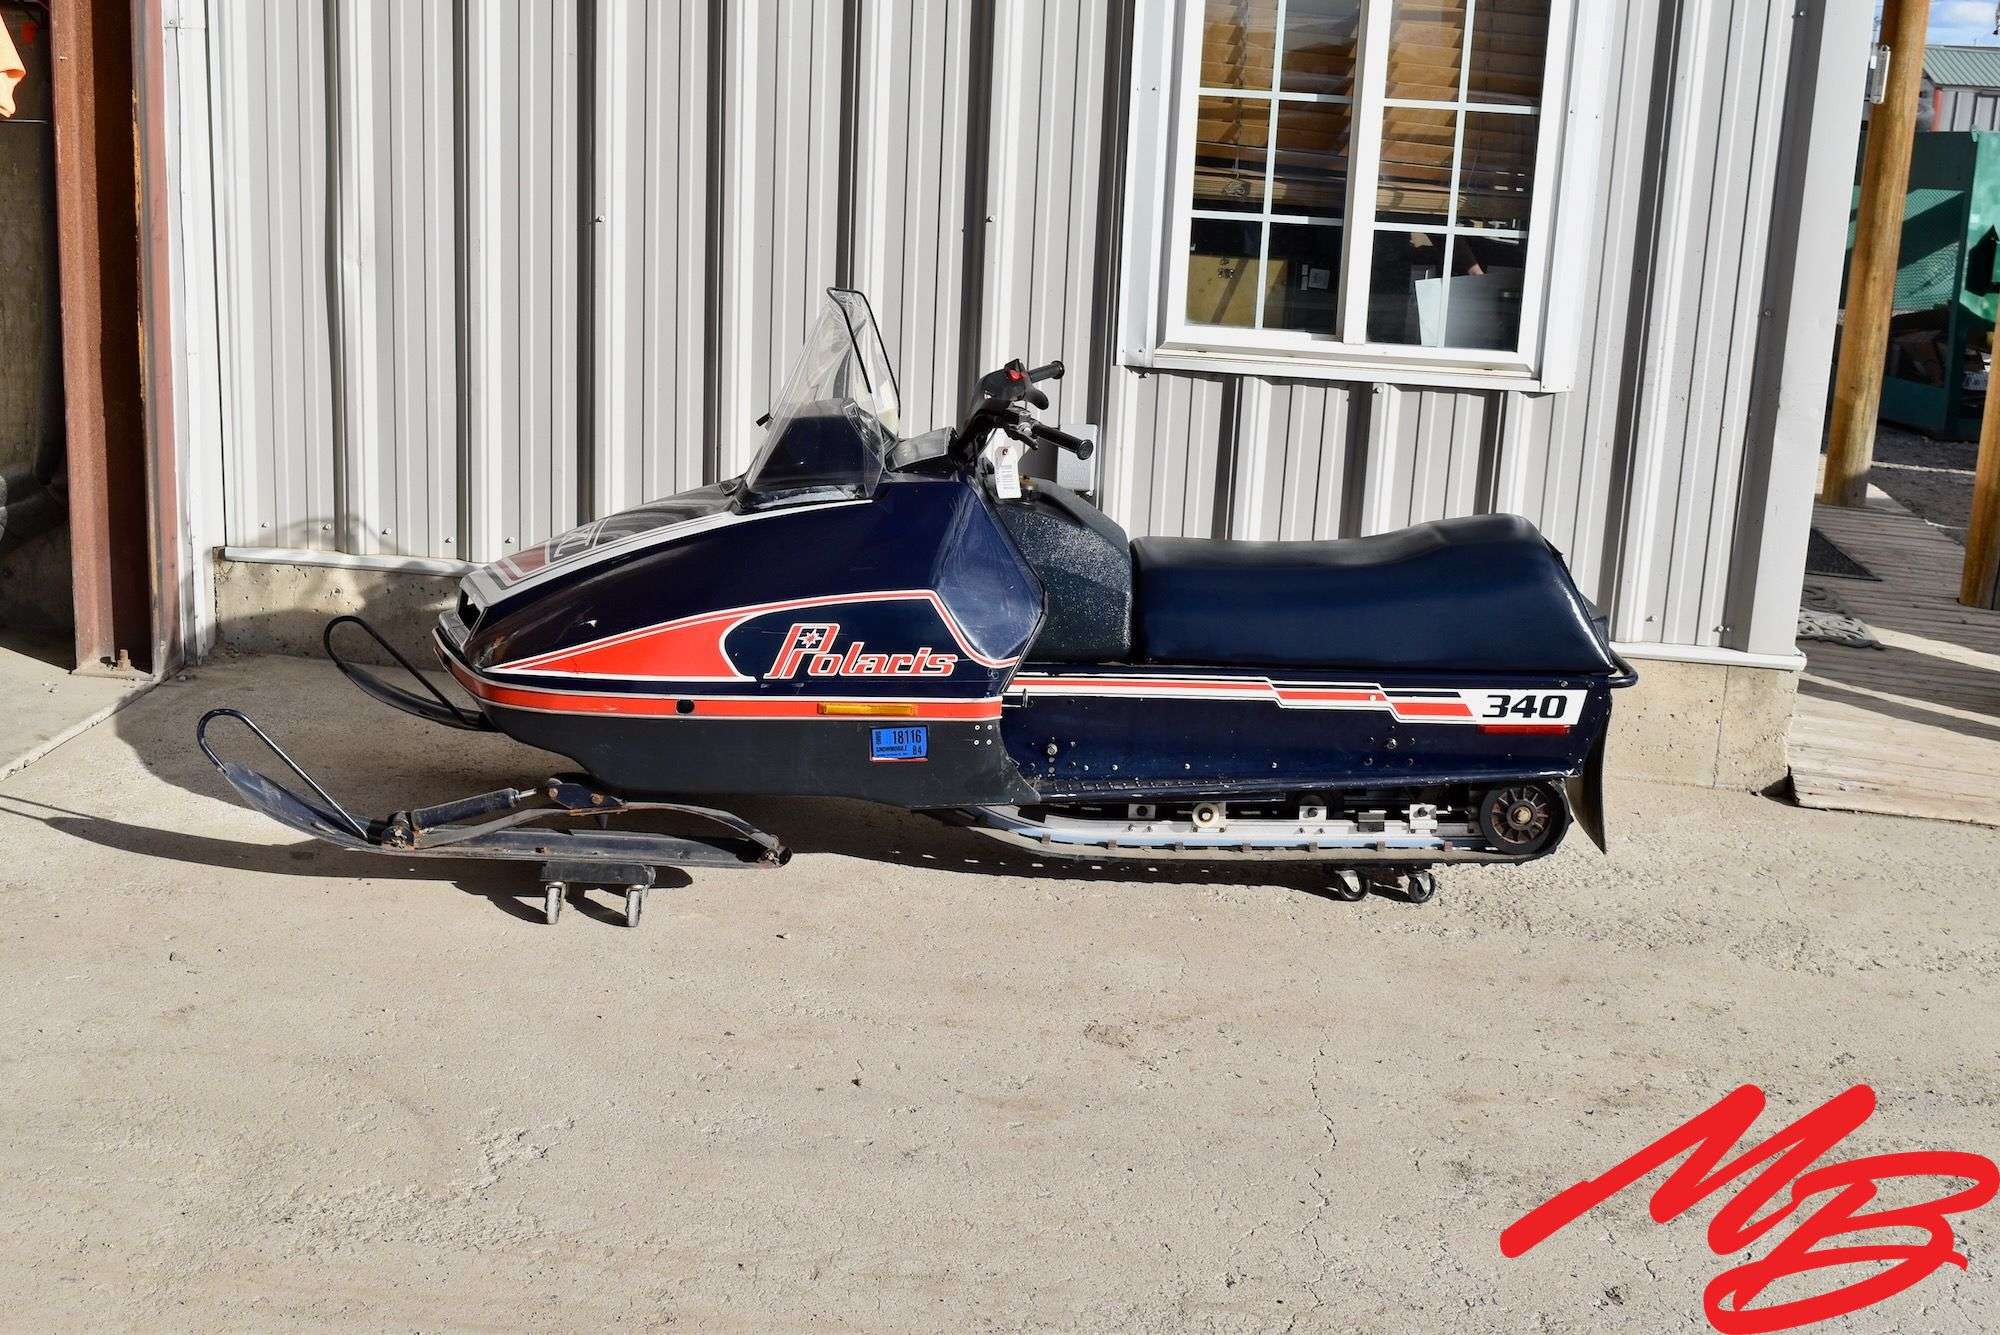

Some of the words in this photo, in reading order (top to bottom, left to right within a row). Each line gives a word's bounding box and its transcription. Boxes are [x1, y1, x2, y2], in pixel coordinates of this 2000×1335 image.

[763, 623, 958, 680] Polaris
[1482, 694, 1568, 719] 340
[893, 729, 922, 745] 18116
